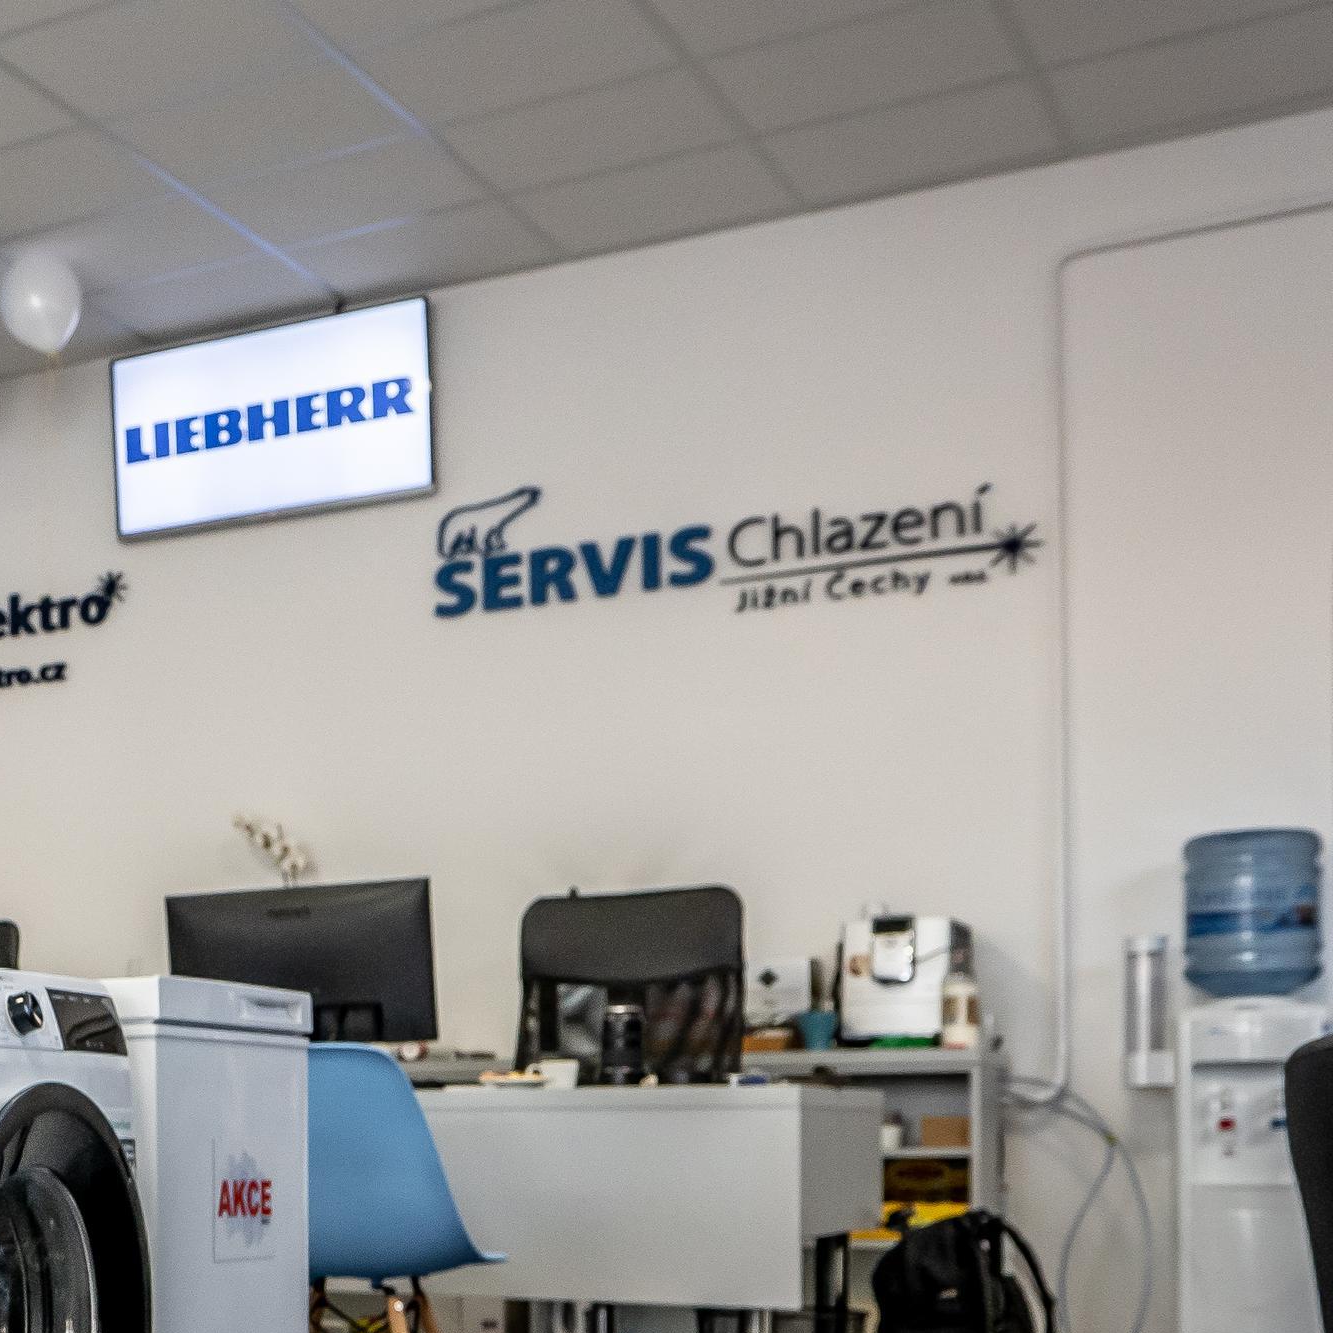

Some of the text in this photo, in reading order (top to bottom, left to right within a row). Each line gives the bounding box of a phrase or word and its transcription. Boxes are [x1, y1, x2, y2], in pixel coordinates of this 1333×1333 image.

[125, 377, 413, 464] LIEBHERR
[434, 481, 992, 619] SERVIS Chlazení
[825, 567, 931, 602] Čechy
[218, 1178, 273, 1218] AKCE
